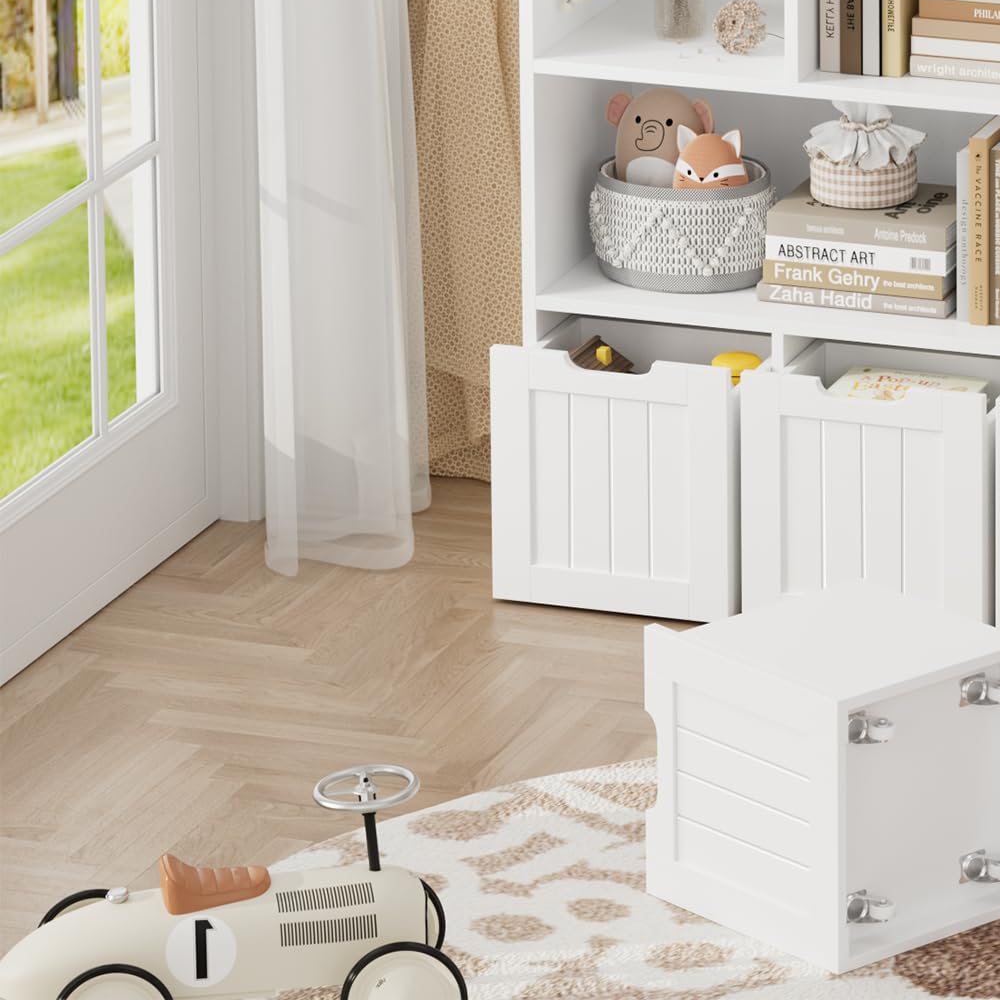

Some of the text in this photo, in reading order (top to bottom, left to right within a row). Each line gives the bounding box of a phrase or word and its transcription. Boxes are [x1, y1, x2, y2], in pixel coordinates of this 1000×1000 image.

[916, 63, 956, 77] wright
[974, 178, 982, 228] VACCINE
[778, 244, 876, 265] ABSTRACT ART
[974, 234, 982, 264] RACE
[774, 263, 880, 291] Frank Gehry
[769, 284, 873, 310] Zaha Hadid
